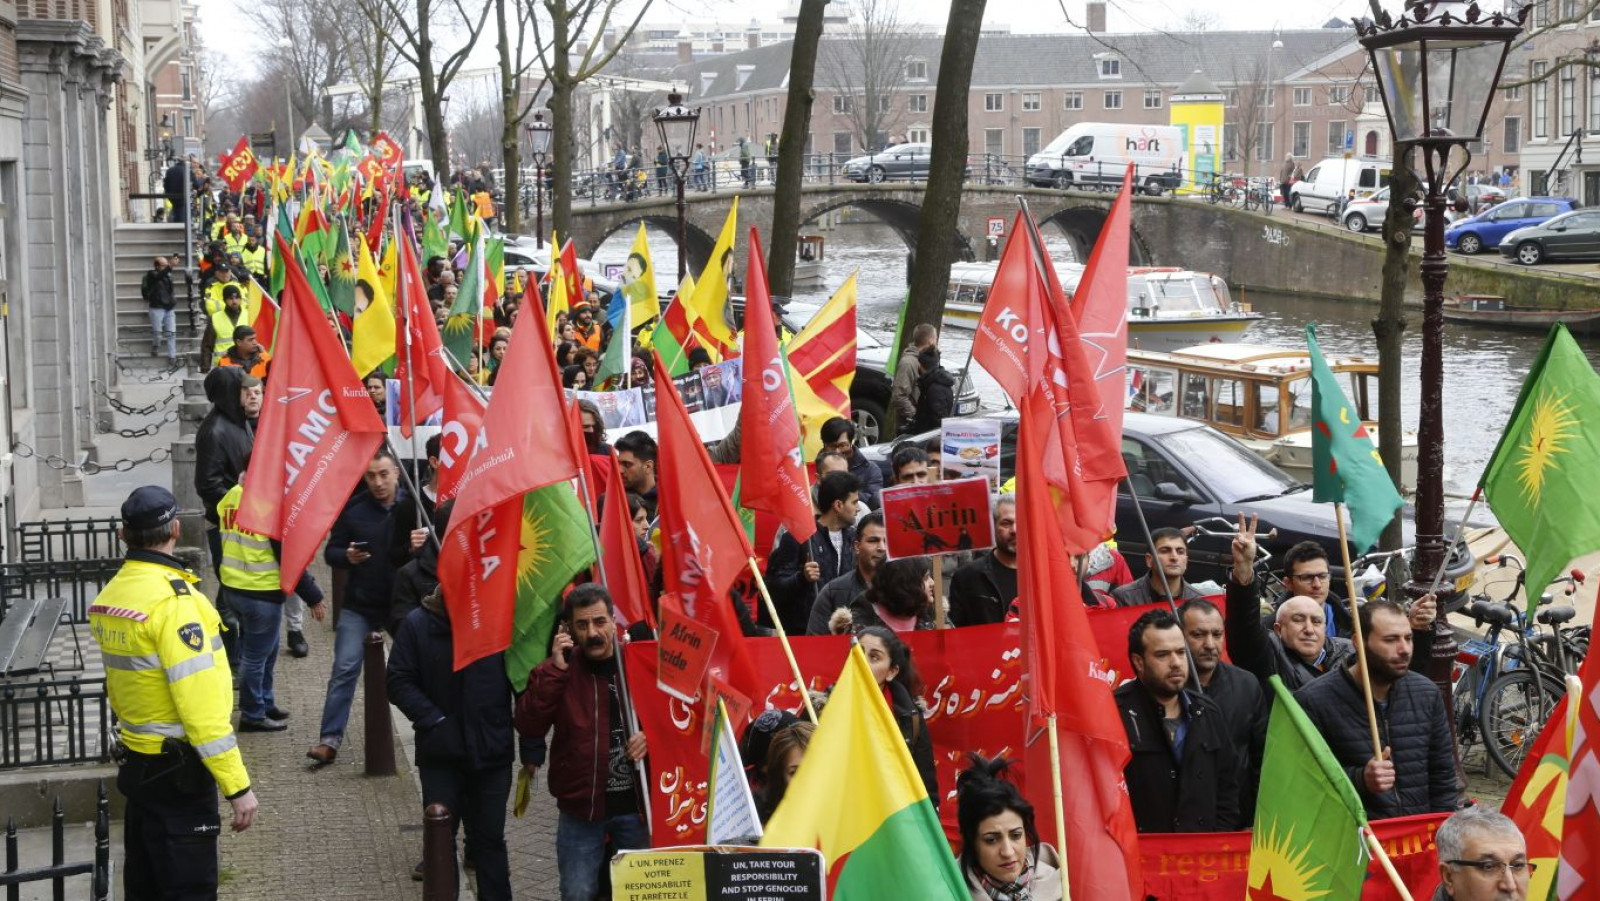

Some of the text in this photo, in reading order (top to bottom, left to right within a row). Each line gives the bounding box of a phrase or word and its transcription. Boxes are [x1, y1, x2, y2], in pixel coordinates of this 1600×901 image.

[1126, 137, 1160, 151] hart
[904, 502, 977, 531] Afrin
[654, 858, 685, 867] PRENEZ
[771, 860, 796, 868] YOUR
[645, 870, 672, 878] VOTRE
[731, 873, 798, 882] RESPONSIBILITY
[721, 885, 809, 895] AND STOP GENOCIDE
[681, 892, 689, 900] LE
